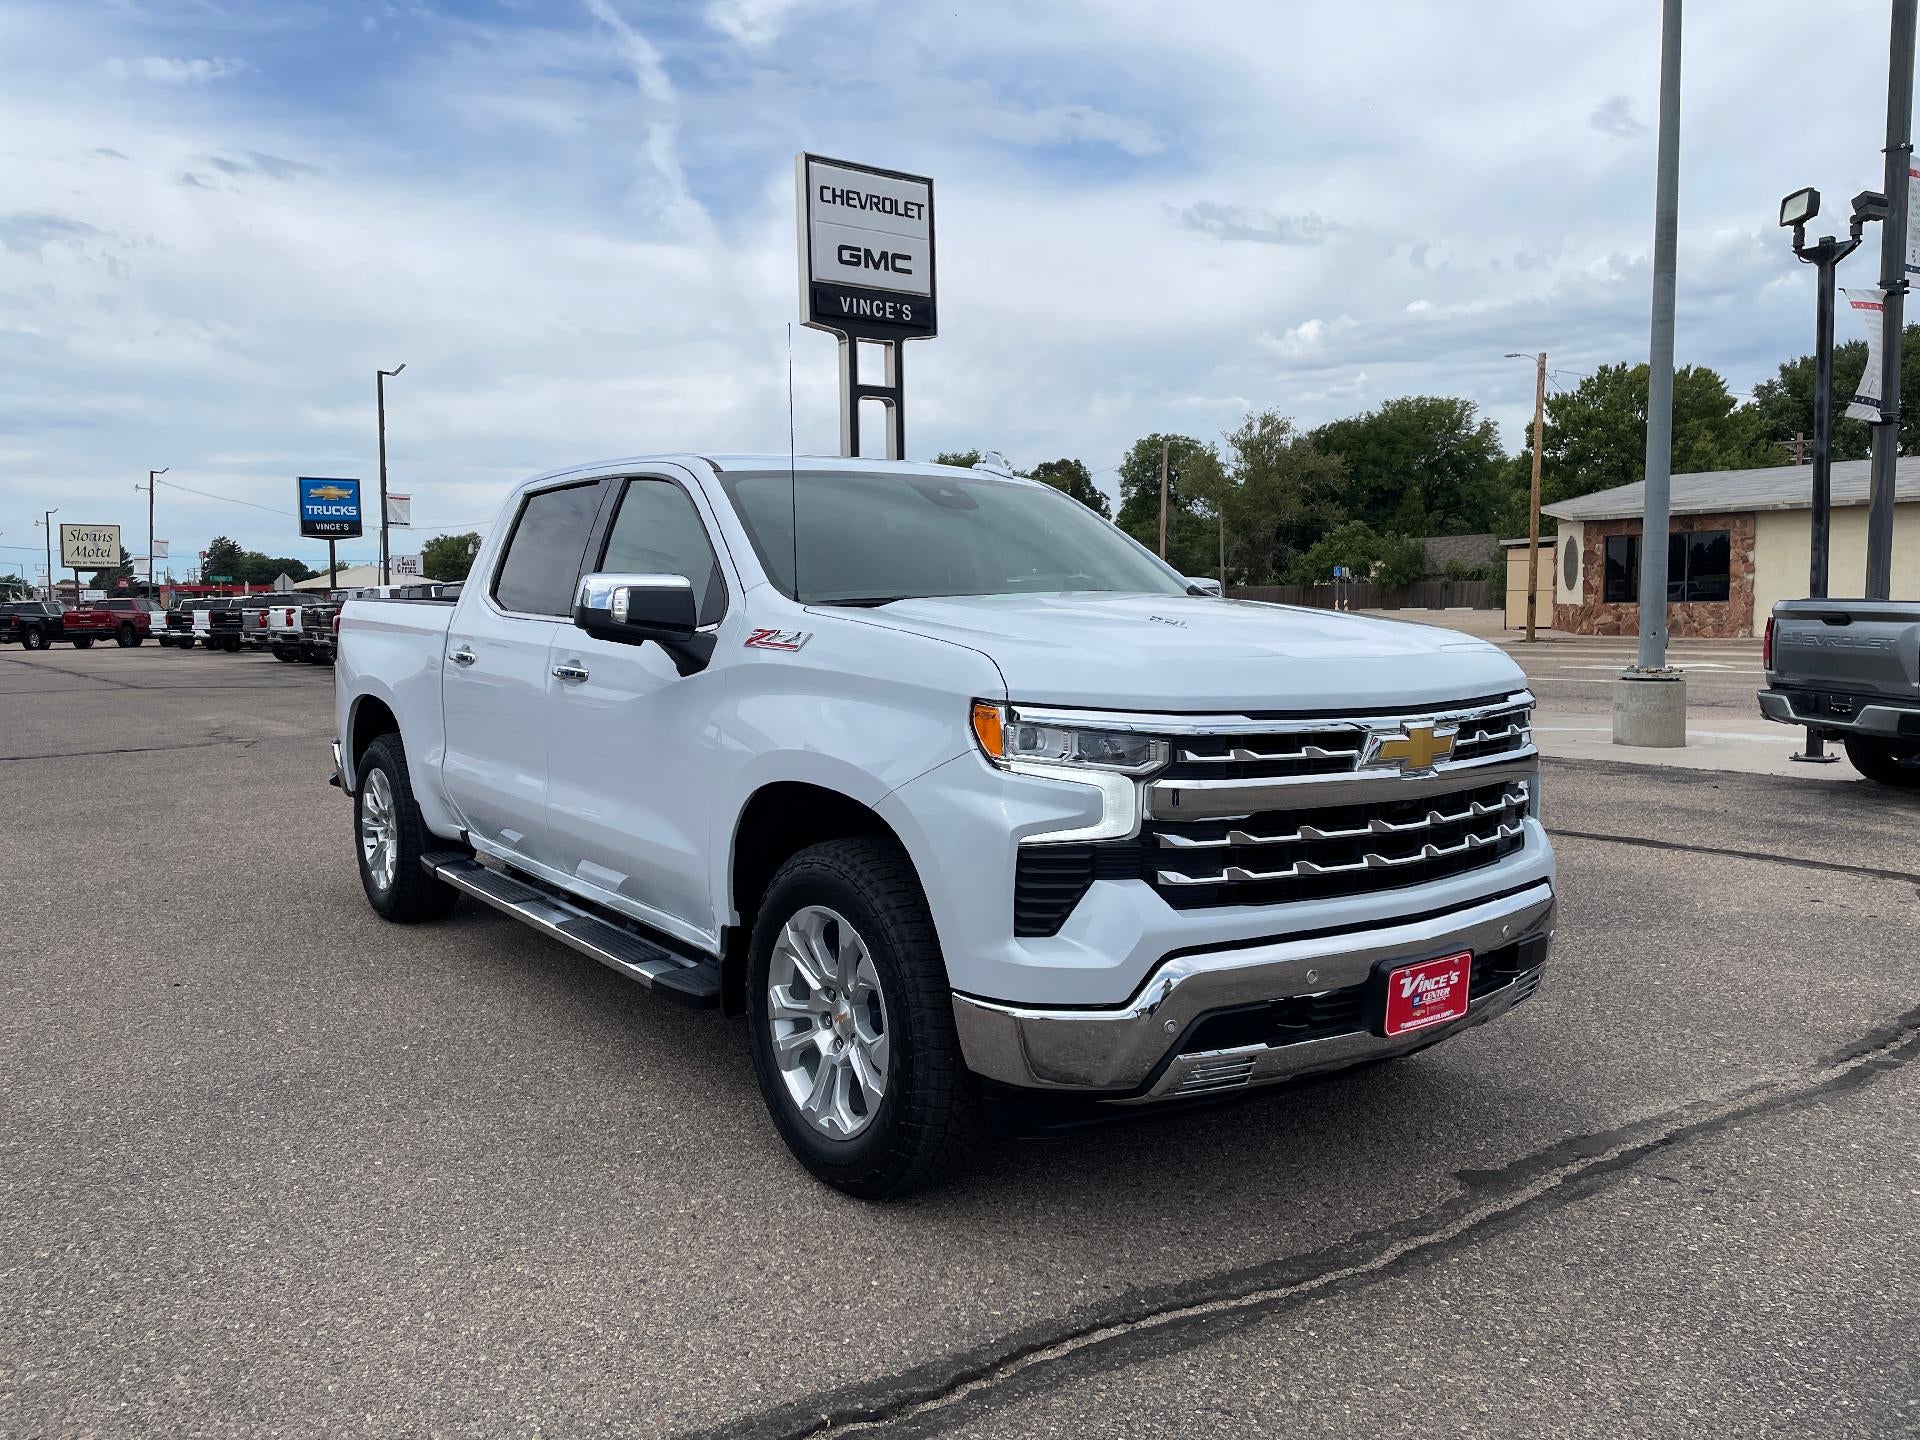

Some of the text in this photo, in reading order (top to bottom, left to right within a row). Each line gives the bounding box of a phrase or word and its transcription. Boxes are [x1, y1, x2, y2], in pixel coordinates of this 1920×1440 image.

[819, 185, 925, 221] CHEVROLET
[837, 244, 913, 275] GMC
[840, 296, 912, 321] VINCE'S
[305, 504, 357, 516] TRUCKS
[315, 522, 349, 531] VINCE'S
[68, 528, 114, 543] Sloans
[70, 544, 112, 558] Motel
[1779, 632, 1896, 650] CHEVROLET
[1422, 987, 1451, 1002] CENTER
